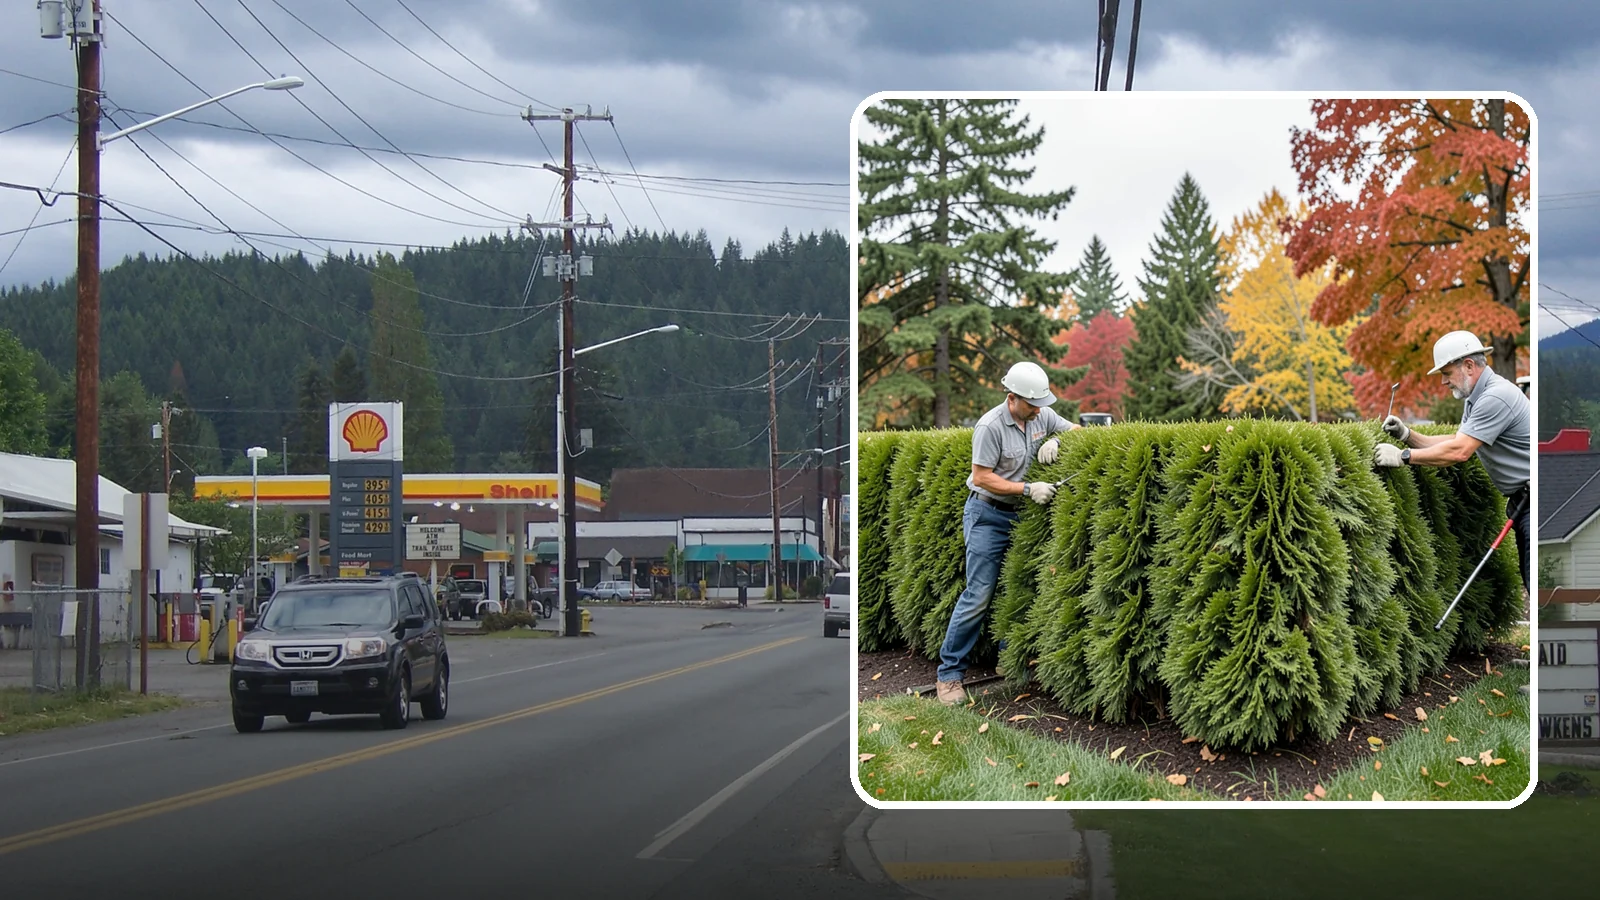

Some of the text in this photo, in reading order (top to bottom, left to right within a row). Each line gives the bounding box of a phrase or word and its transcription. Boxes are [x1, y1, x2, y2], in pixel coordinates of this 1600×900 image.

[366, 480, 383, 490] 395
[490, 484, 547, 499] Shell
[366, 494, 383, 504] 405
[366, 508, 383, 518] 415
[1538, 643, 1567, 665] AID
